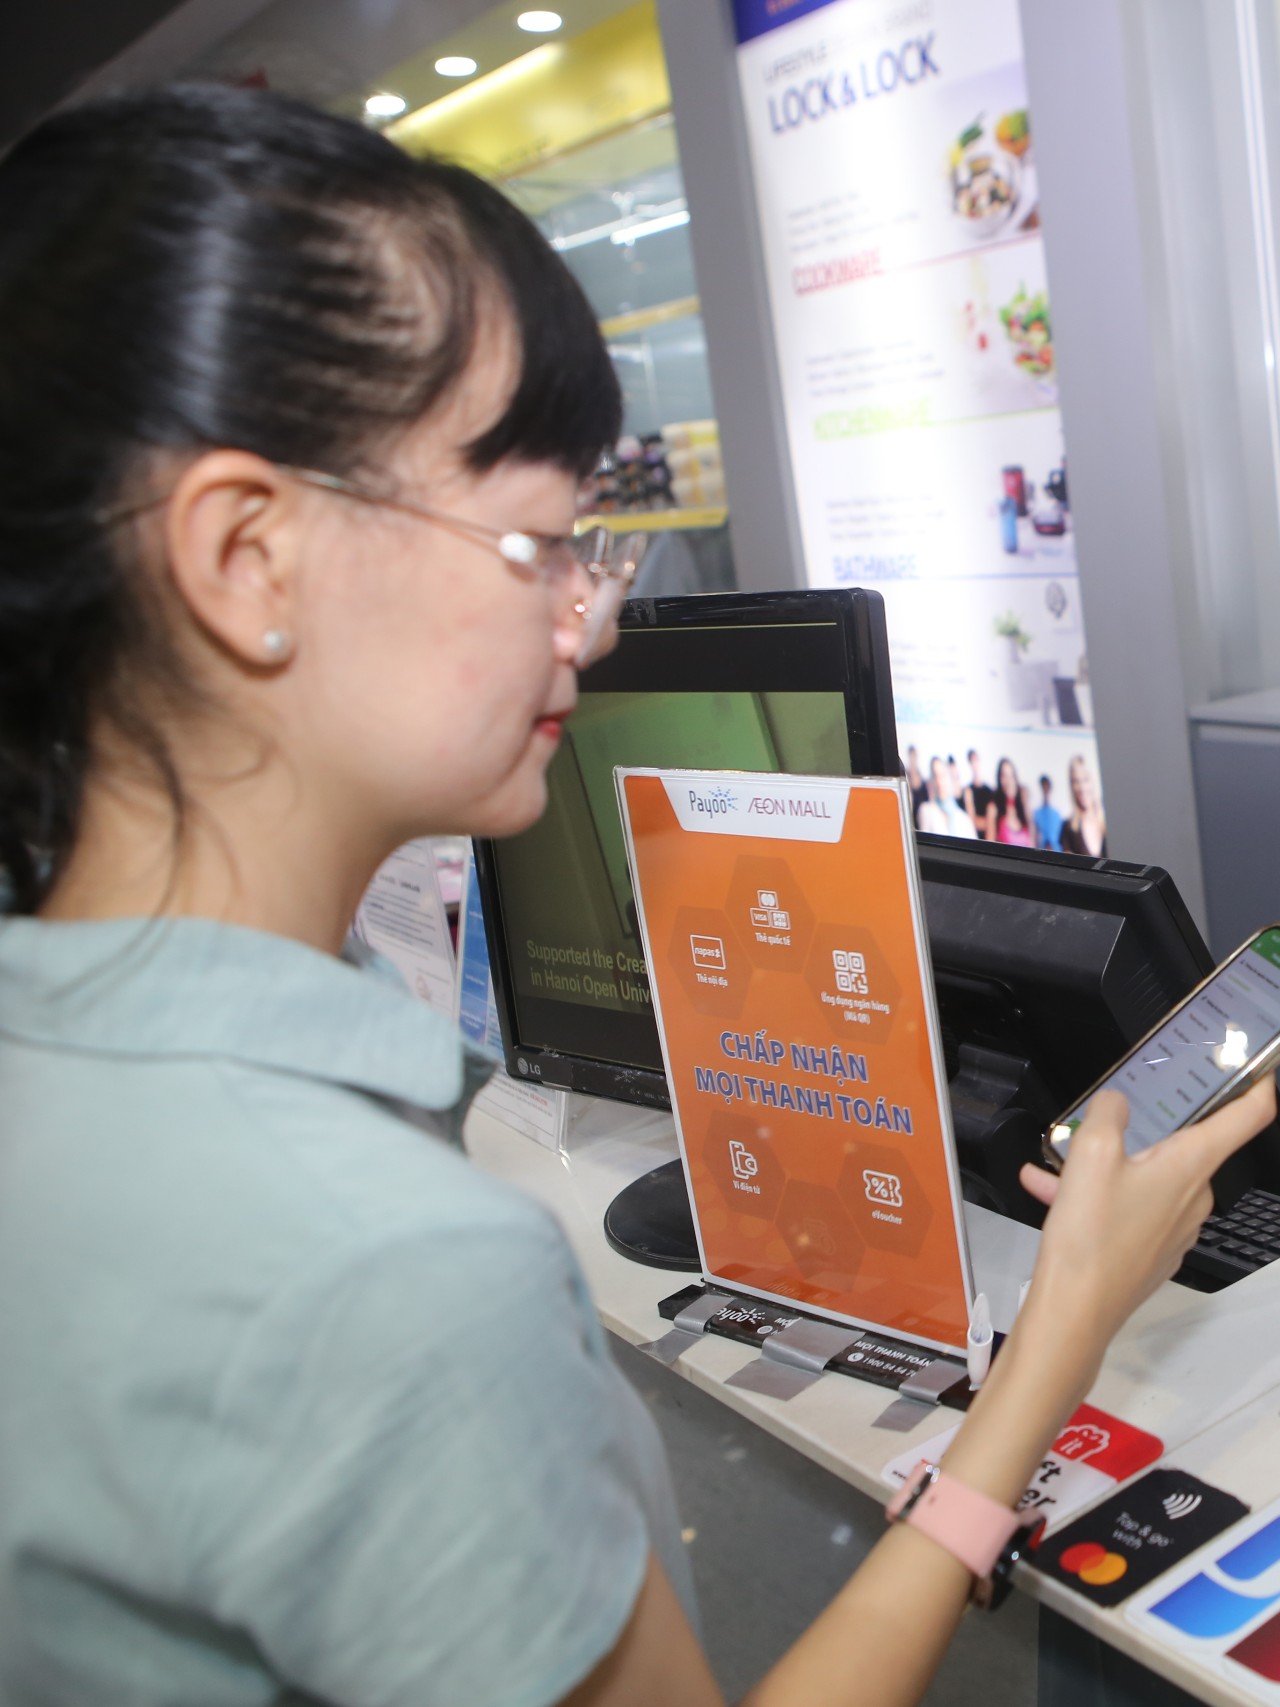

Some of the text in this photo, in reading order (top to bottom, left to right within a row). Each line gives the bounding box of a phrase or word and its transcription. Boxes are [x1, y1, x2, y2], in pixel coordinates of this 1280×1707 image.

[689, 790, 727, 818] Payoo
[789, 800, 831, 818] MALL
[526, 939, 648, 974] Supported the Crea
[530, 967, 650, 1003] in Hanoi Open Univ
[529, 1064, 541, 1076] LG
[720, 1029, 869, 1087] CHẤP NHẬN
[694, 1066, 914, 1136] MỌI THANH TOÁN
[863, 1356, 884, 1368] 1900
[874, 1345, 906, 1360] THANH
[905, 1357, 933, 1367] TOÁN
[1116, 1511, 1140, 1531] Tap
[1138, 1524, 1152, 1537] &
